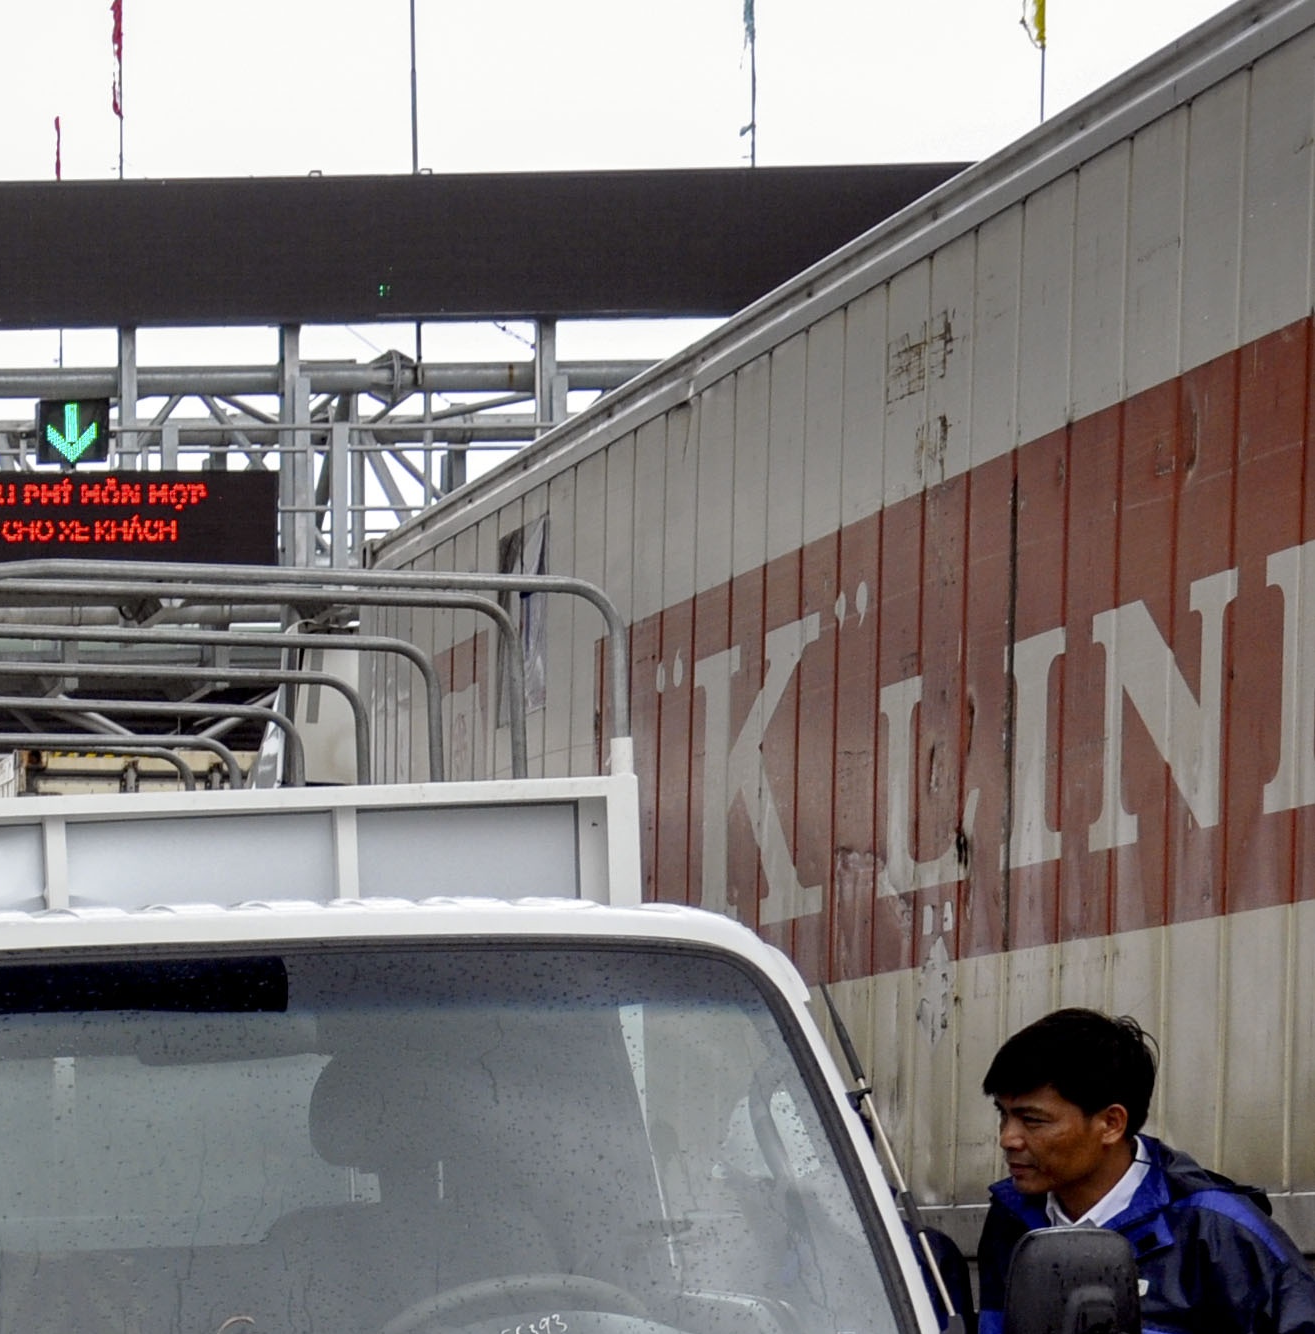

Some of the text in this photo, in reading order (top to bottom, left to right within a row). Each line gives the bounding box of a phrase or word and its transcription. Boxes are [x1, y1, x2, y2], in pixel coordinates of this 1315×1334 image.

[22, 477, 73, 505] PHÍ
[0, 519, 55, 542] CHO
[57, 519, 90, 542] XE
[93, 513, 177, 542] KHÁCH
